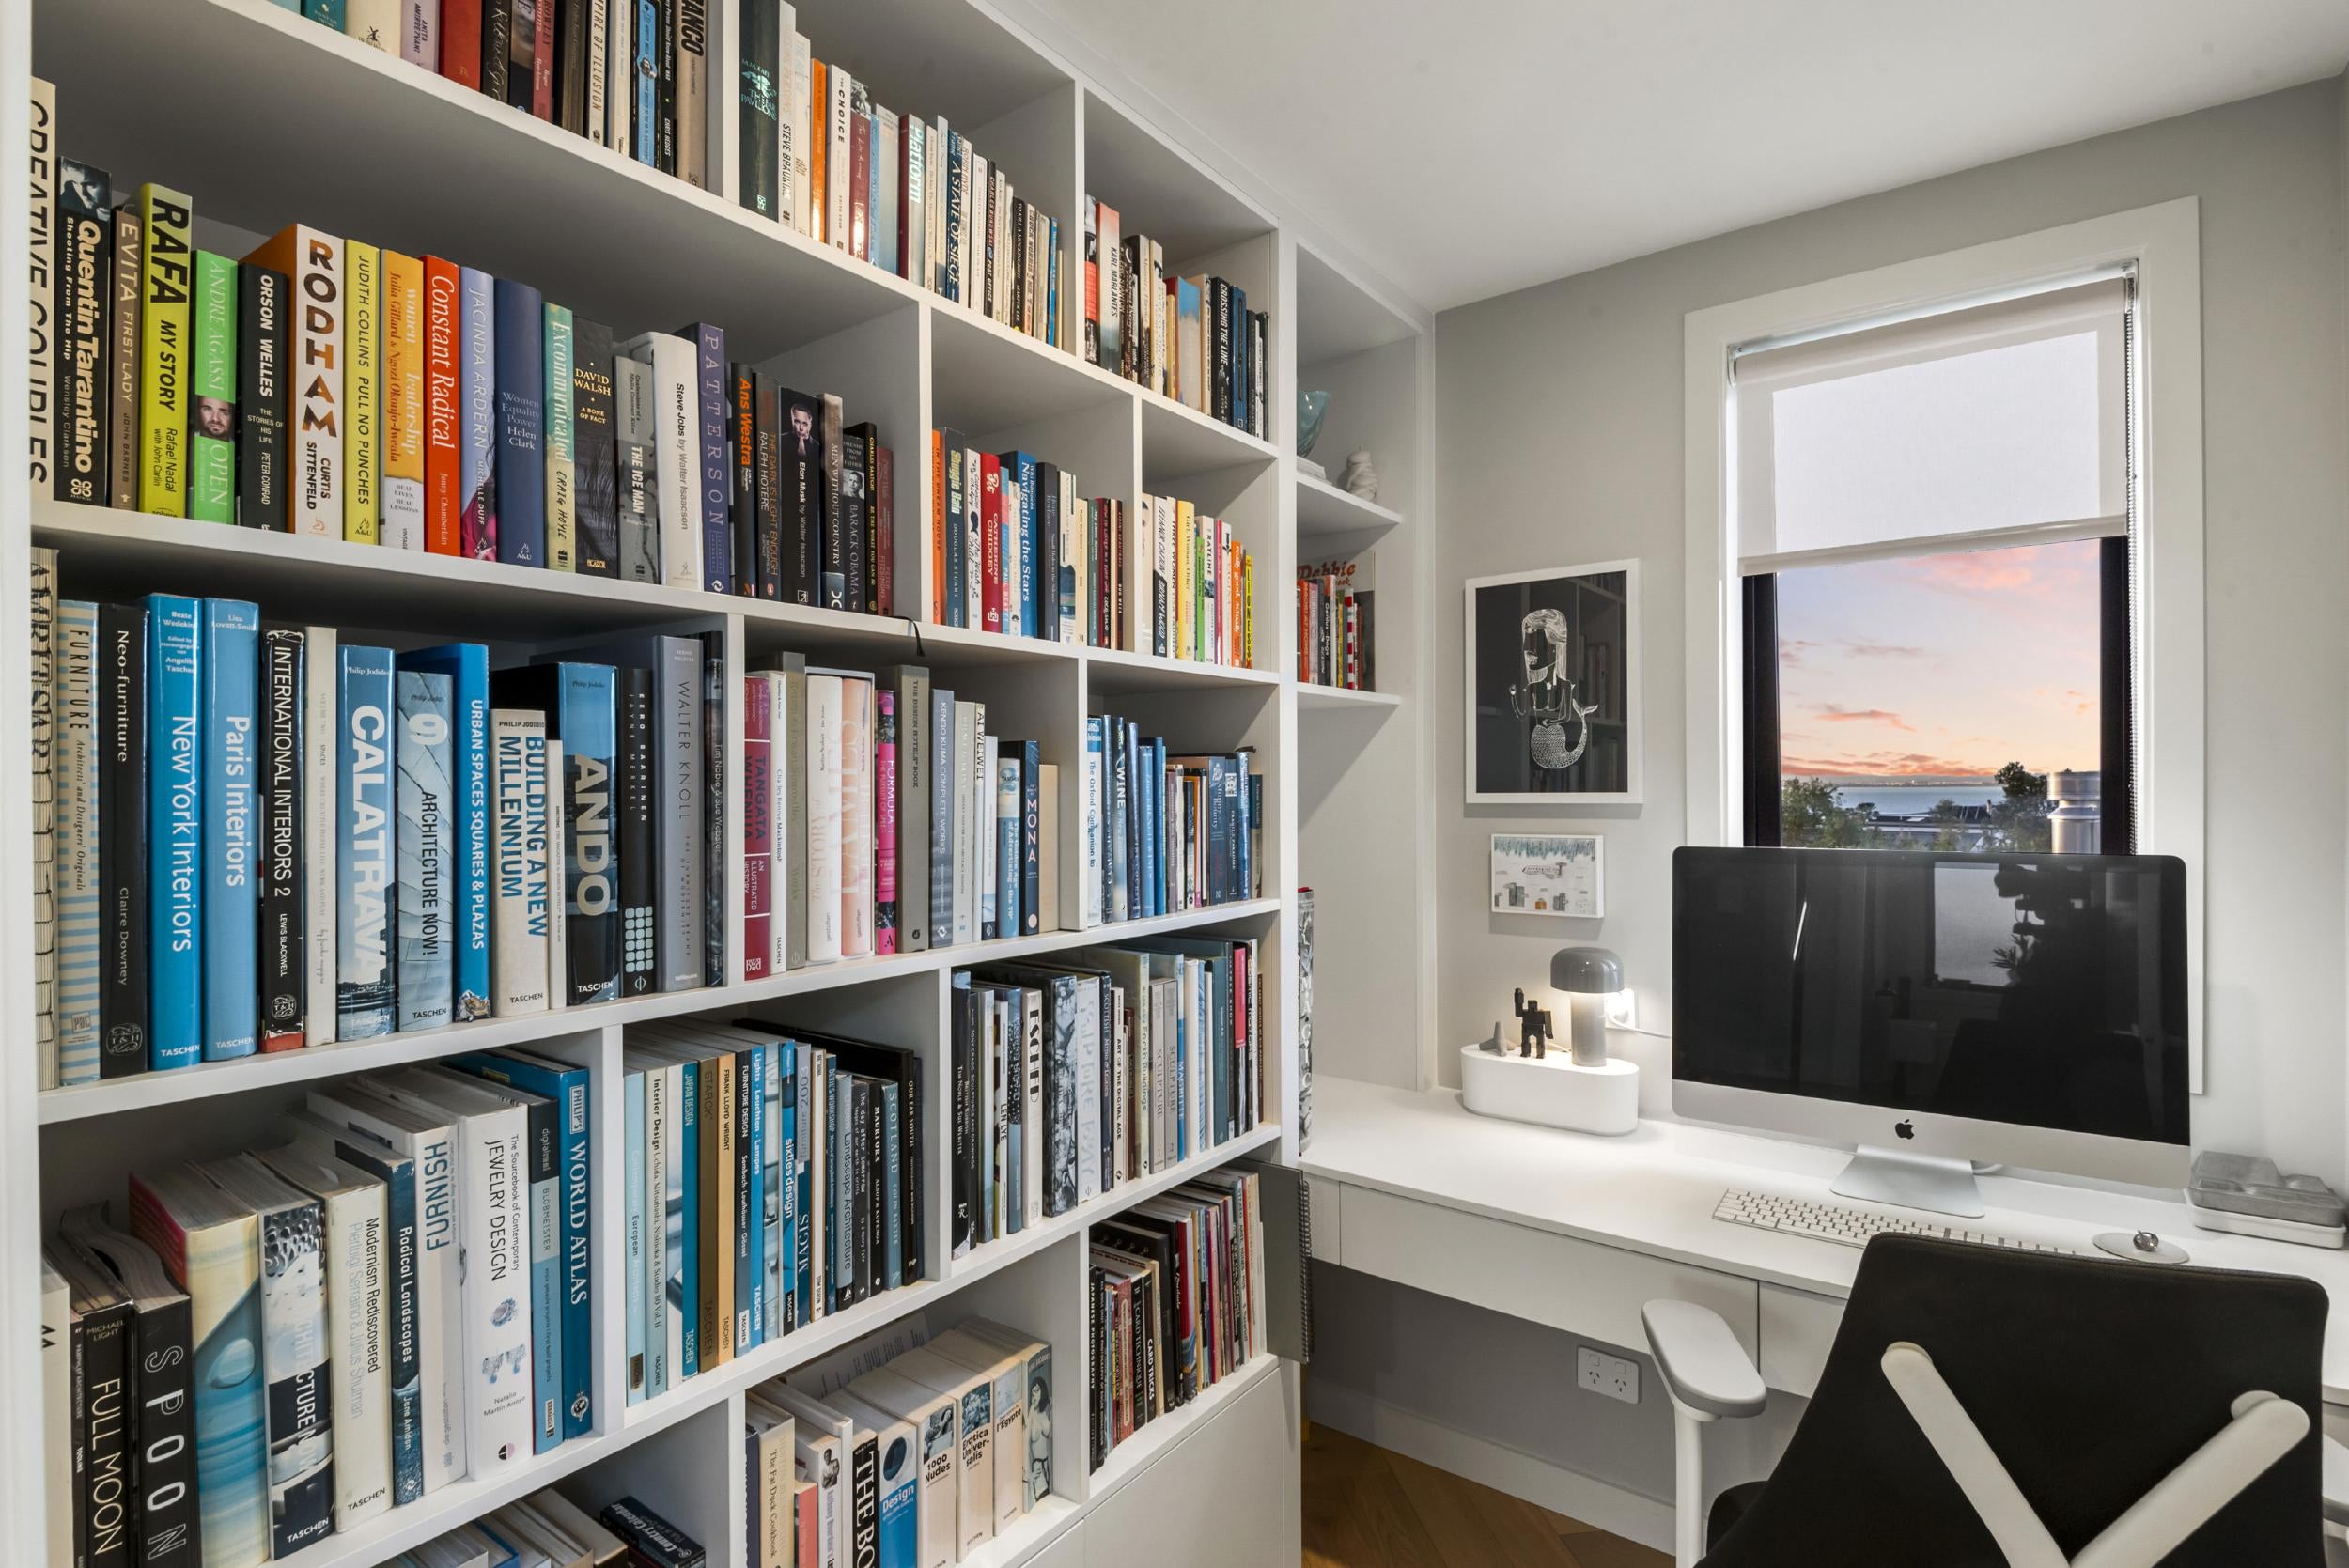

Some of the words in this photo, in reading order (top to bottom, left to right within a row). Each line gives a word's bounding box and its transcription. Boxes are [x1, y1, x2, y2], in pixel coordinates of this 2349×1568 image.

[593, 36, 603, 52] OF
[592, 55, 603, 112] ILLUSION
[782, 123, 791, 150] STEVE
[952, 161, 961, 174] A
[951, 176, 961, 217] STATE
[64, 216, 74, 272] Shooting
[149, 197, 189, 303] RAFA
[950, 222, 960, 241] OF
[76, 219, 101, 334] Quentin
[120, 223, 139, 301] EVITA
[358, 256, 370, 305] JUDITH
[948, 241, 960, 286] SIEGE
[64, 276, 73, 306] From
[259, 274, 273, 331] ORSON
[64, 313, 72, 334] The
[121, 312, 133, 357] FIRST
[160, 319, 177, 349] MY
[302, 239, 337, 438] RODHAM
[358, 309, 370, 368] COLLINS
[431, 275, 455, 368] Constant
[469, 287, 487, 365] JACINDA
[64, 341, 72, 361] Hip
[259, 339, 273, 397] WELLES
[120, 363, 132, 403] LADY
[159, 351, 177, 411] STORY
[358, 377, 369, 409] PULL
[502, 392, 539, 409] Women
[573, 378, 611, 396] WALSH
[575, 367, 610, 385] DAVID
[677, 382, 685, 411] Steve
[739, 377, 752, 410] Ans
[75, 337, 99, 473] Tarantino
[358, 414, 369, 436] NO
[431, 372, 455, 449] Radical
[474, 371, 488, 449] ARDERN
[502, 403, 540, 420] Equality
[507, 414, 536, 427] Power
[677, 412, 686, 437] Jobs
[507, 426, 537, 441] Helen
[508, 437, 536, 451] Clark
[677, 437, 686, 451] by
[705, 334, 723, 526] PATTERSON
[739, 411, 752, 467] Westra
[760, 432, 769, 468] RALPH
[210, 444, 229, 505] OPEN
[261, 452, 271, 476] PETER
[306, 441, 317, 510] SITTENFELD
[320, 458, 331, 500] CURTIS
[358, 441, 369, 505] PUNCHES
[678, 454, 690, 484] Walter
[260, 476, 271, 505] CONRAD
[679, 485, 689, 531] Isaacson
[760, 470, 770, 511] HOTERE
[1020, 462, 1031, 537] Navigating
[849, 505, 859, 548] BARACK
[849, 551, 859, 595] OBAMA
[1022, 567, 1031, 602] Stars
[69, 630, 90, 730] FURNITURE
[117, 630, 130, 763] Neo-furniture
[274, 646, 292, 785] INTERNATIONAL
[471, 700, 483, 749] URBAN
[678, 681, 691, 749] WALTER
[977, 712, 984, 725] AI
[172, 716, 197, 774] New
[226, 716, 252, 776] Paris
[976, 729, 985, 780] WEIWEI
[471, 753, 484, 807] SPACES
[524, 737, 546, 851] BUILDING
[678, 762, 691, 820] KNOLL
[755, 756, 767, 840] TANGATA
[1116, 768, 1126, 808] WINE
[172, 779, 198, 835] York
[499, 737, 522, 897] MILLENNIUM
[1027, 800, 1037, 862] MONA
[226, 783, 252, 887] Interiors
[274, 789, 292, 881] INTERIORS
[351, 706, 386, 982] CALATRAVA
[422, 791, 438, 908] ARCHITECTURE
[471, 811, 484, 877] SQUARES
[574, 753, 611, 916] ANDO
[472, 878, 485, 891] &
[527, 859, 547, 875] A
[119, 887, 129, 927] Claire
[172, 842, 198, 952] Interiors
[274, 887, 291, 897] 2
[527, 882, 548, 937] NEW
[422, 913, 439, 955] NOW!
[472, 894, 485, 950] PLAZAS
[118, 931, 129, 986] Downey
[280, 936, 288, 977] BLACKWELL
[653, 1079, 661, 1115] Interior
[511, 1134, 520, 1151] The
[652, 1118, 661, 1150] Design
[889, 1093, 898, 1173] SCOTLAND
[424, 1141, 450, 1252] FURNISH
[484, 1140, 506, 1209] JEWELRY
[511, 1152, 520, 1202] Sourcebook
[570, 1141, 586, 1228] WORLD
[511, 1203, 520, 1212] of
[542, 1188, 551, 1251] BLOBMEISTER
[366, 1217, 380, 1286] Modernism
[399, 1225, 413, 1279] Radical
[490, 1216, 506, 1281] DESIGN
[510, 1212, 521, 1271] Contemporary
[570, 1235, 587, 1305] ATLAS
[86, 1319, 125, 1336] MICHAEL
[93, 1327, 120, 1342] LIGHT
[366, 1288, 381, 1374] Rediscovered
[398, 1280, 413, 1363] Landscapes
[705, 1300, 714, 1356] TASCHEN
[91, 1378, 121, 1452] FULL
[144, 1345, 187, 1560] SPOON
[770, 1449, 778, 1469] The
[927, 1453, 948, 1471] 1000
[962, 1428, 989, 1452] Erotica
[962, 1437, 989, 1460] Univer-
[965, 1450, 983, 1467] salis
[770, 1470, 778, 1485] Fat
[857, 1451, 875, 1527] THE
[925, 1461, 951, 1485] Nudes
[92, 1452, 123, 1556] MOON
[348, 1487, 385, 1511] TASCHEN
[770, 1486, 779, 1514] Duck
[882, 1484, 914, 1514] Design
[287, 1517, 329, 1543] TASCHEN
[770, 1514, 780, 1558] Cookbook
